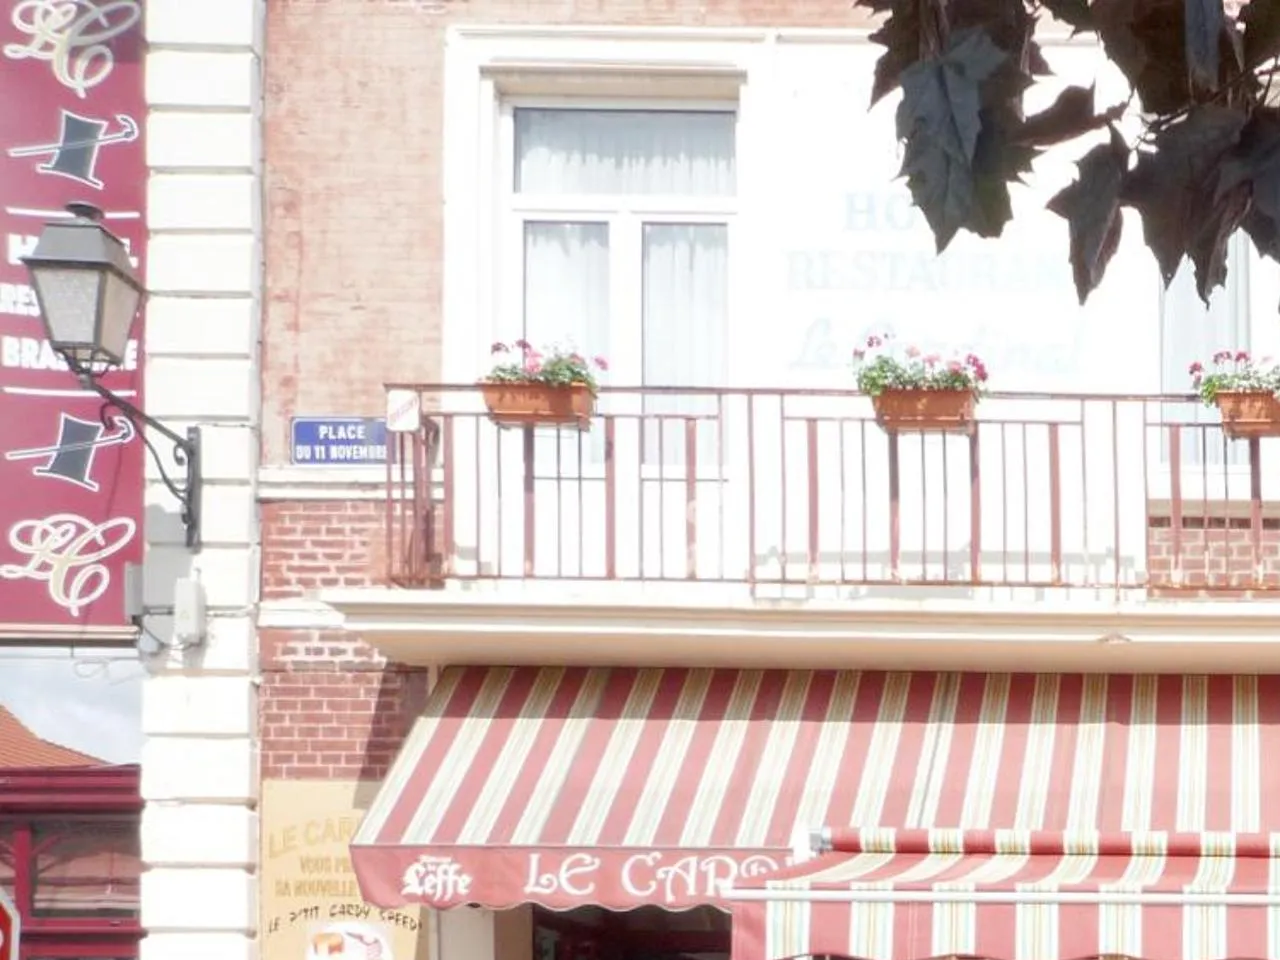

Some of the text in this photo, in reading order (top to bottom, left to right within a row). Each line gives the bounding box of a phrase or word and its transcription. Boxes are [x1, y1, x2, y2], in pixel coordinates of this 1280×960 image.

[319, 425, 366, 440] PLACE
[315, 445, 326, 459] 11
[524, 852, 601, 896] LE
